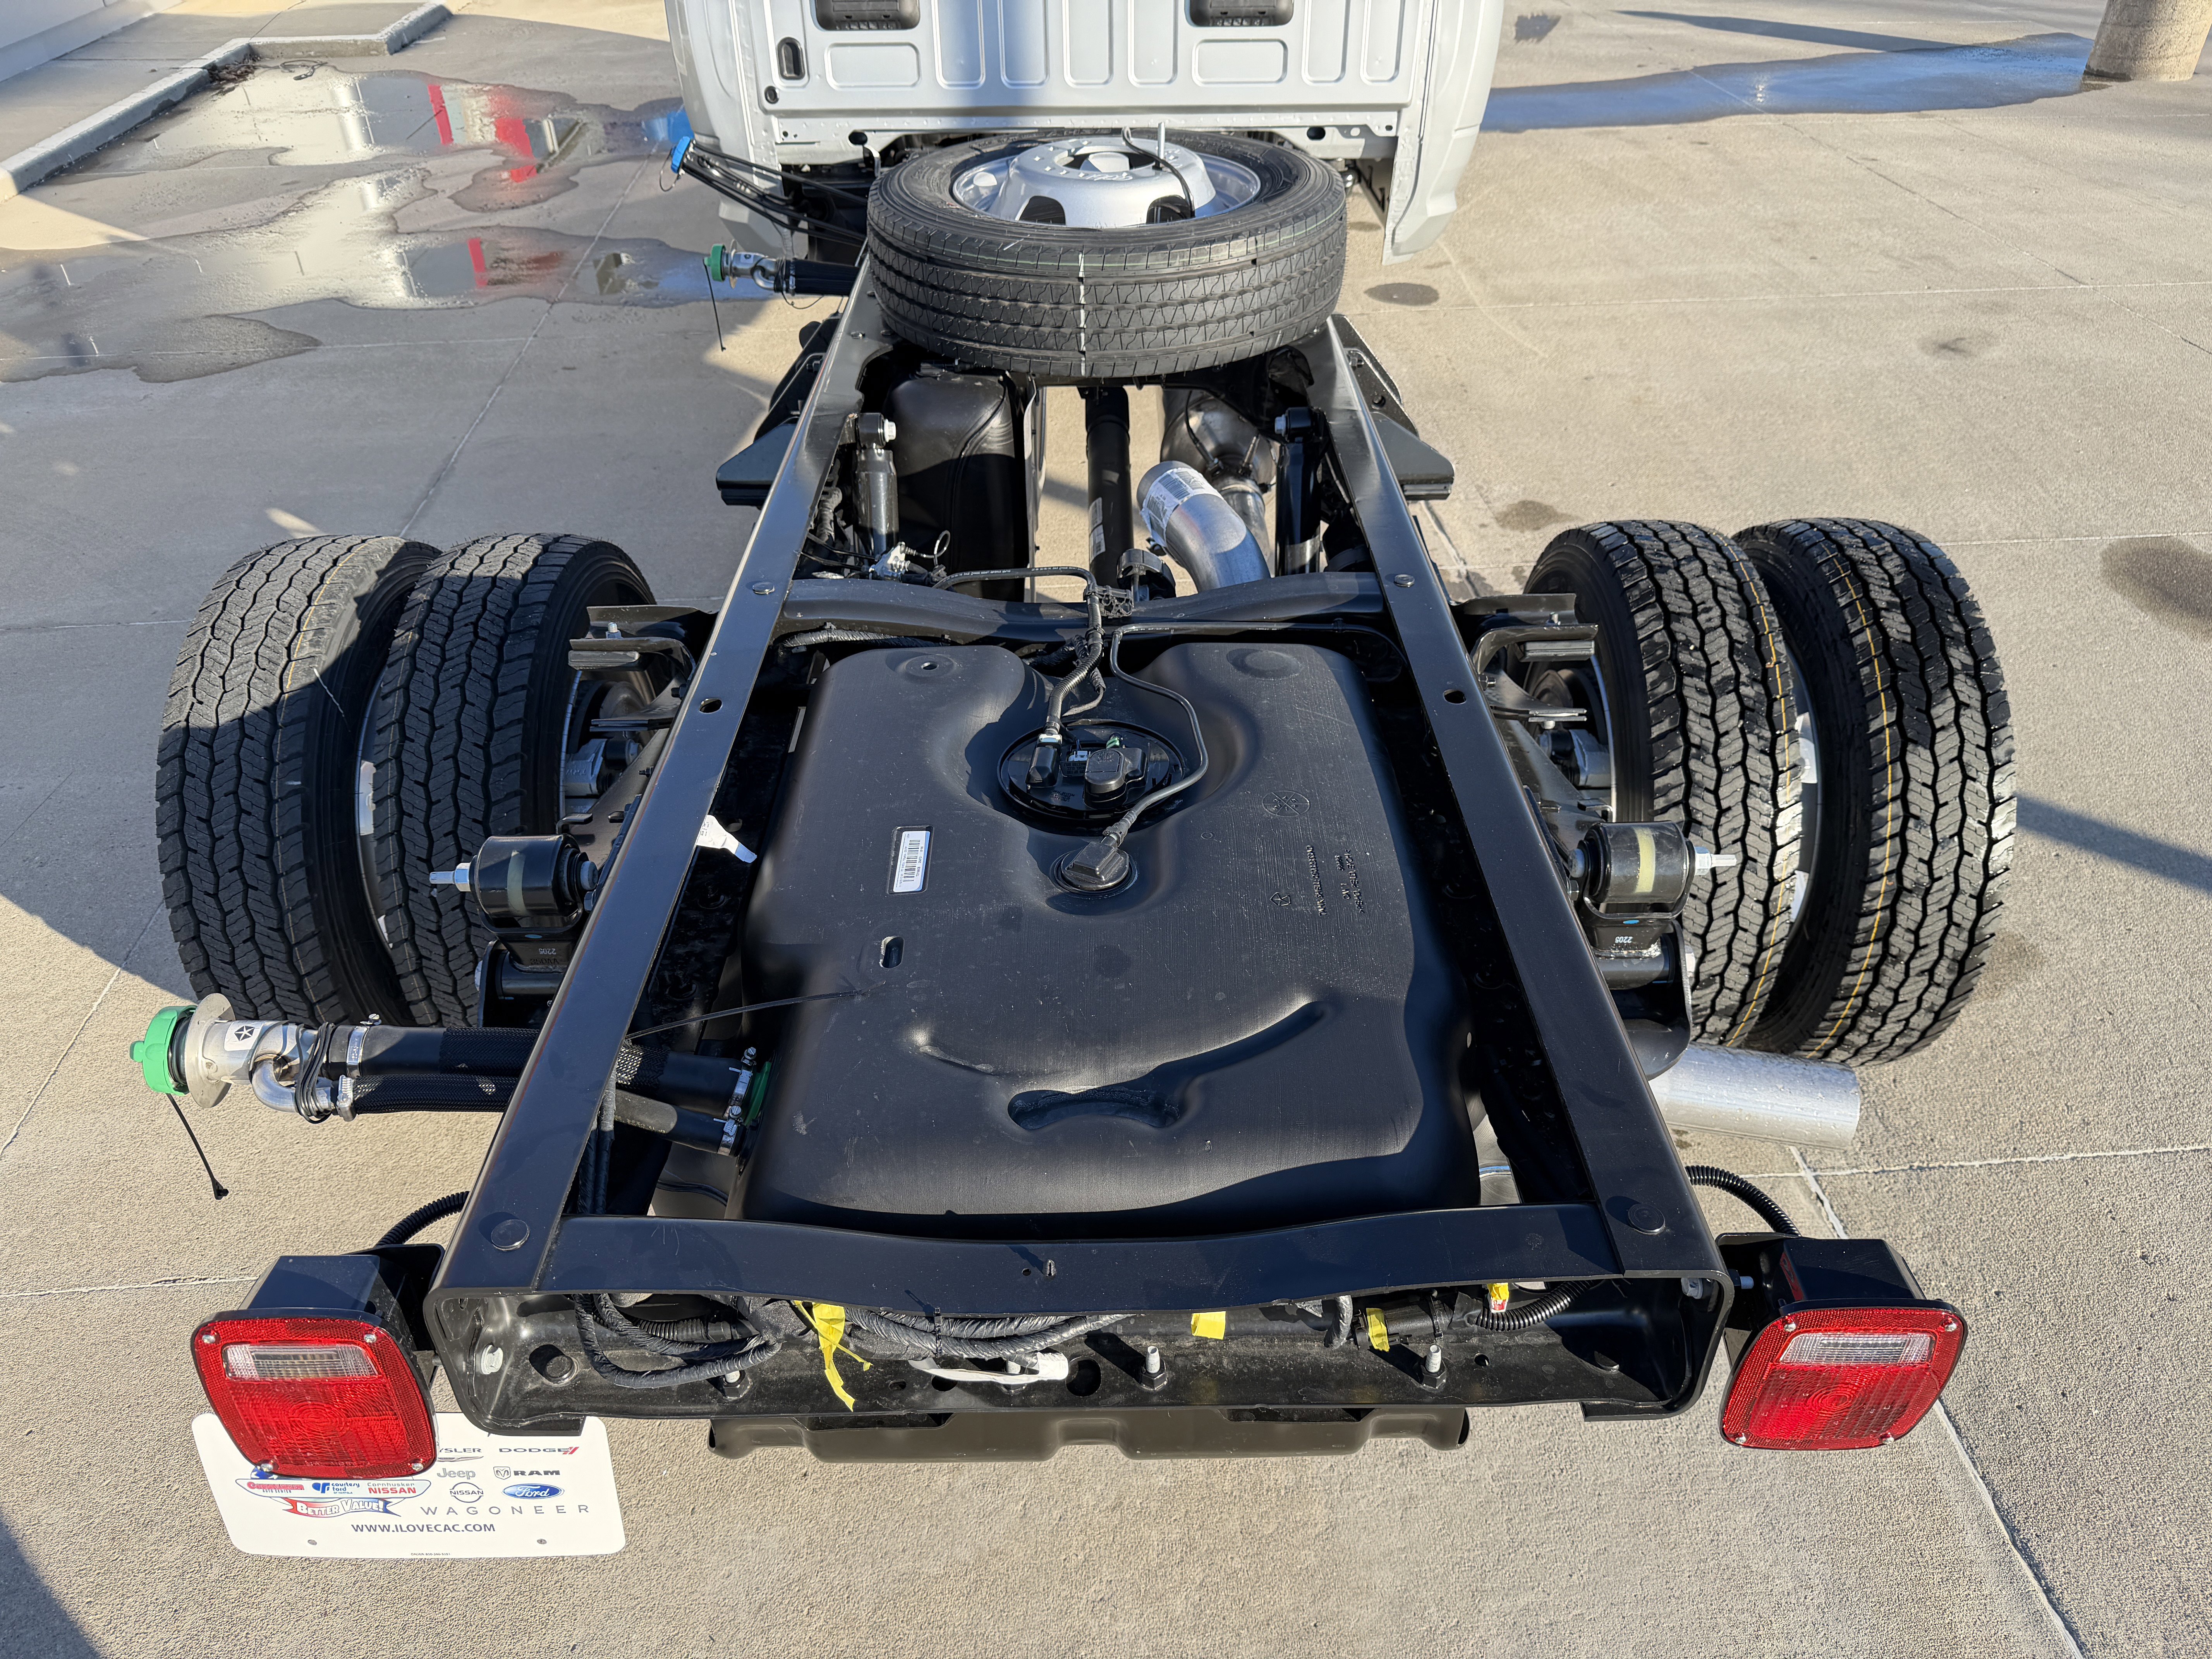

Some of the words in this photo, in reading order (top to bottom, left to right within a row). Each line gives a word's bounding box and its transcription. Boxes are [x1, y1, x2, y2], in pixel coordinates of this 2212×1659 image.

[437, 1468, 476, 1479] Jeep
[515, 1486, 550, 1497] Ford
[297, 1501, 340, 1516] BETTER
[340, 1499, 385, 1513] VALUE!
[420, 1505, 589, 1515] WAGONEER
[351, 1524, 495, 1532] WWW.ILOVECAC.COM
